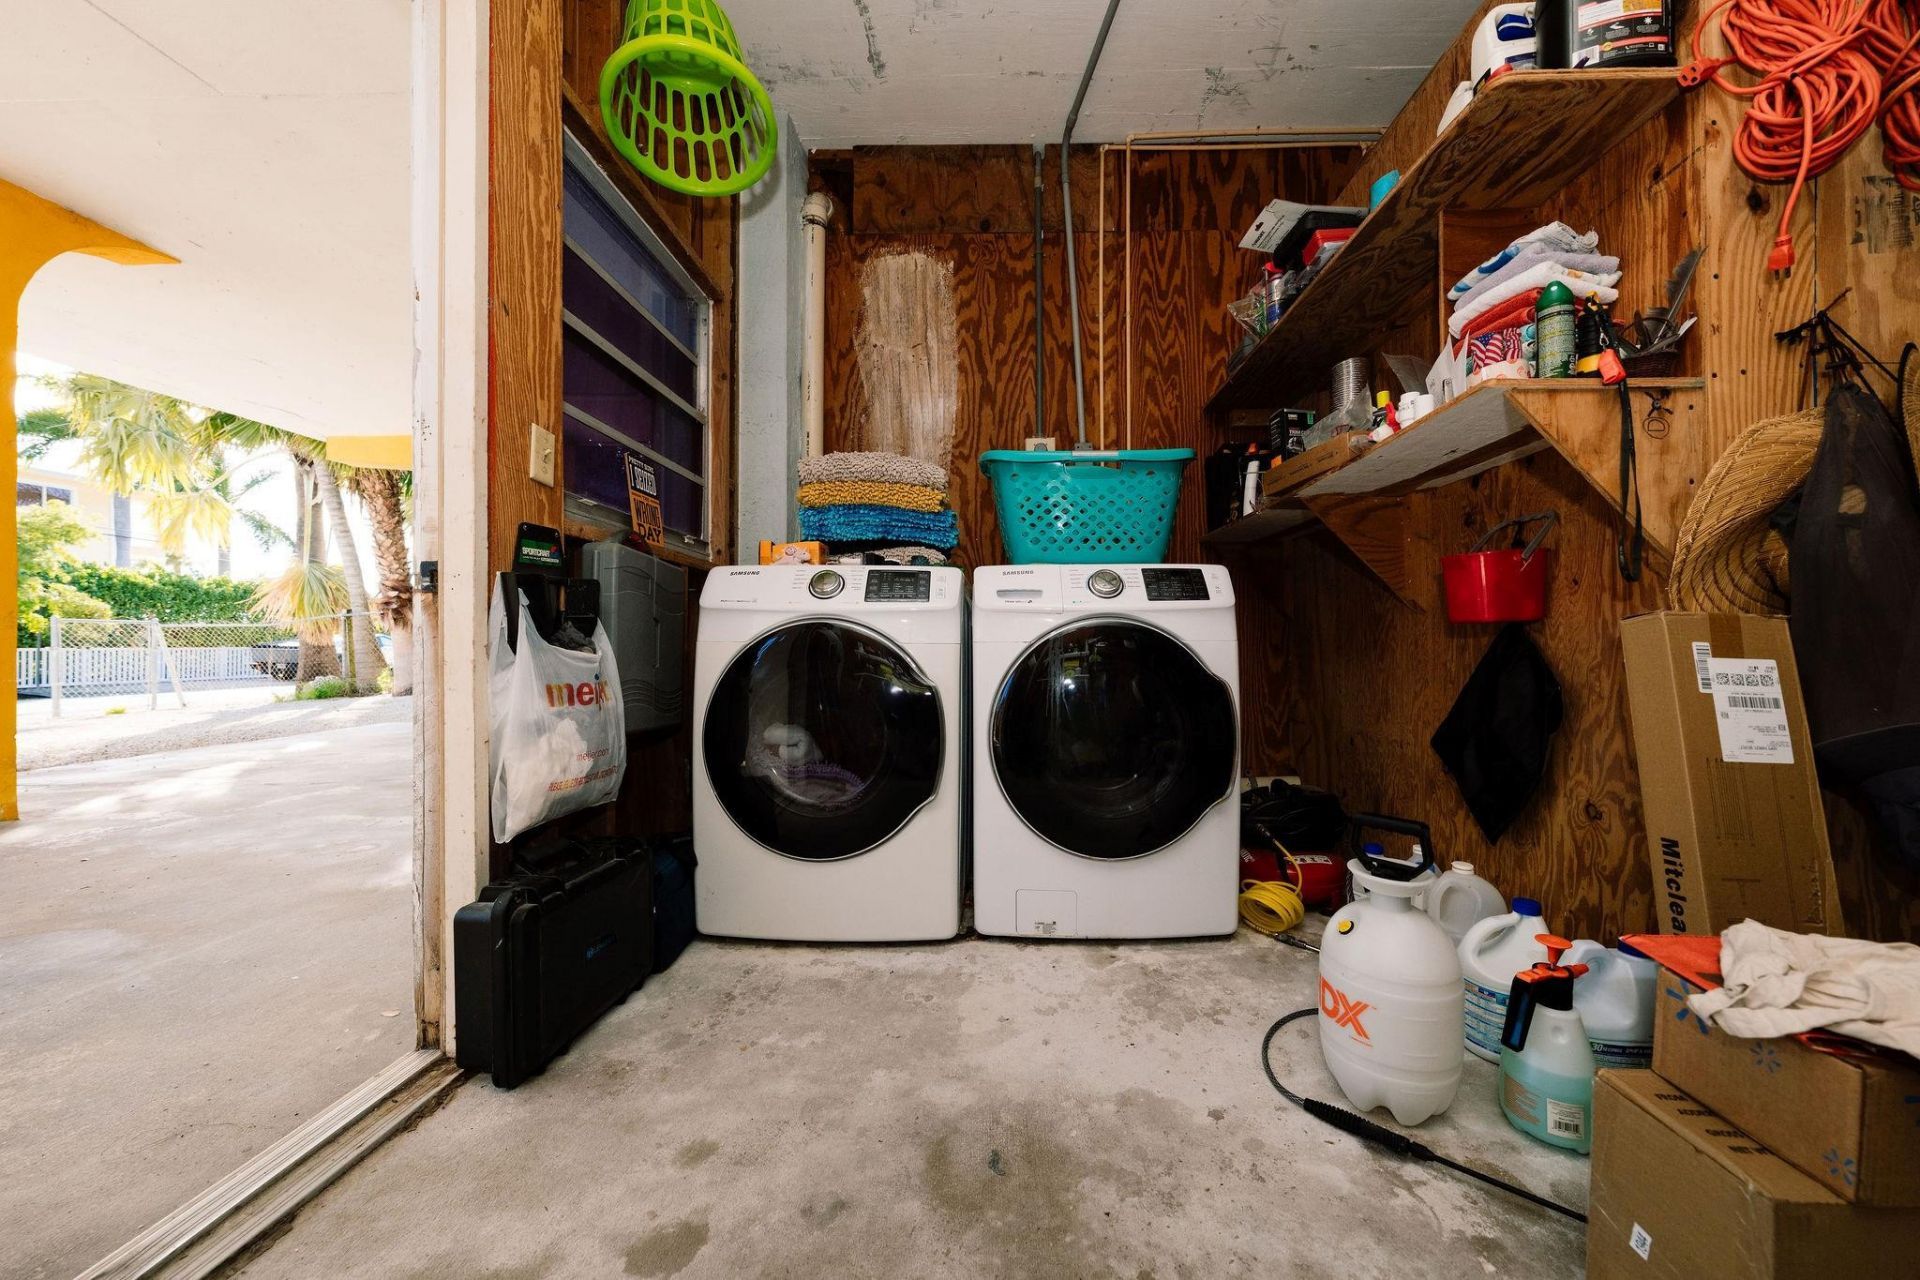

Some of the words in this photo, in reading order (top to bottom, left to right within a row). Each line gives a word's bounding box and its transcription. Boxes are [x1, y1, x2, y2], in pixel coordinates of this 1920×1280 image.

[633, 497, 661, 529] WRONG
[637, 522, 661, 544] DAY
[1660, 836, 1687, 936] Mitclea
[1319, 976, 1370, 1040] DX
